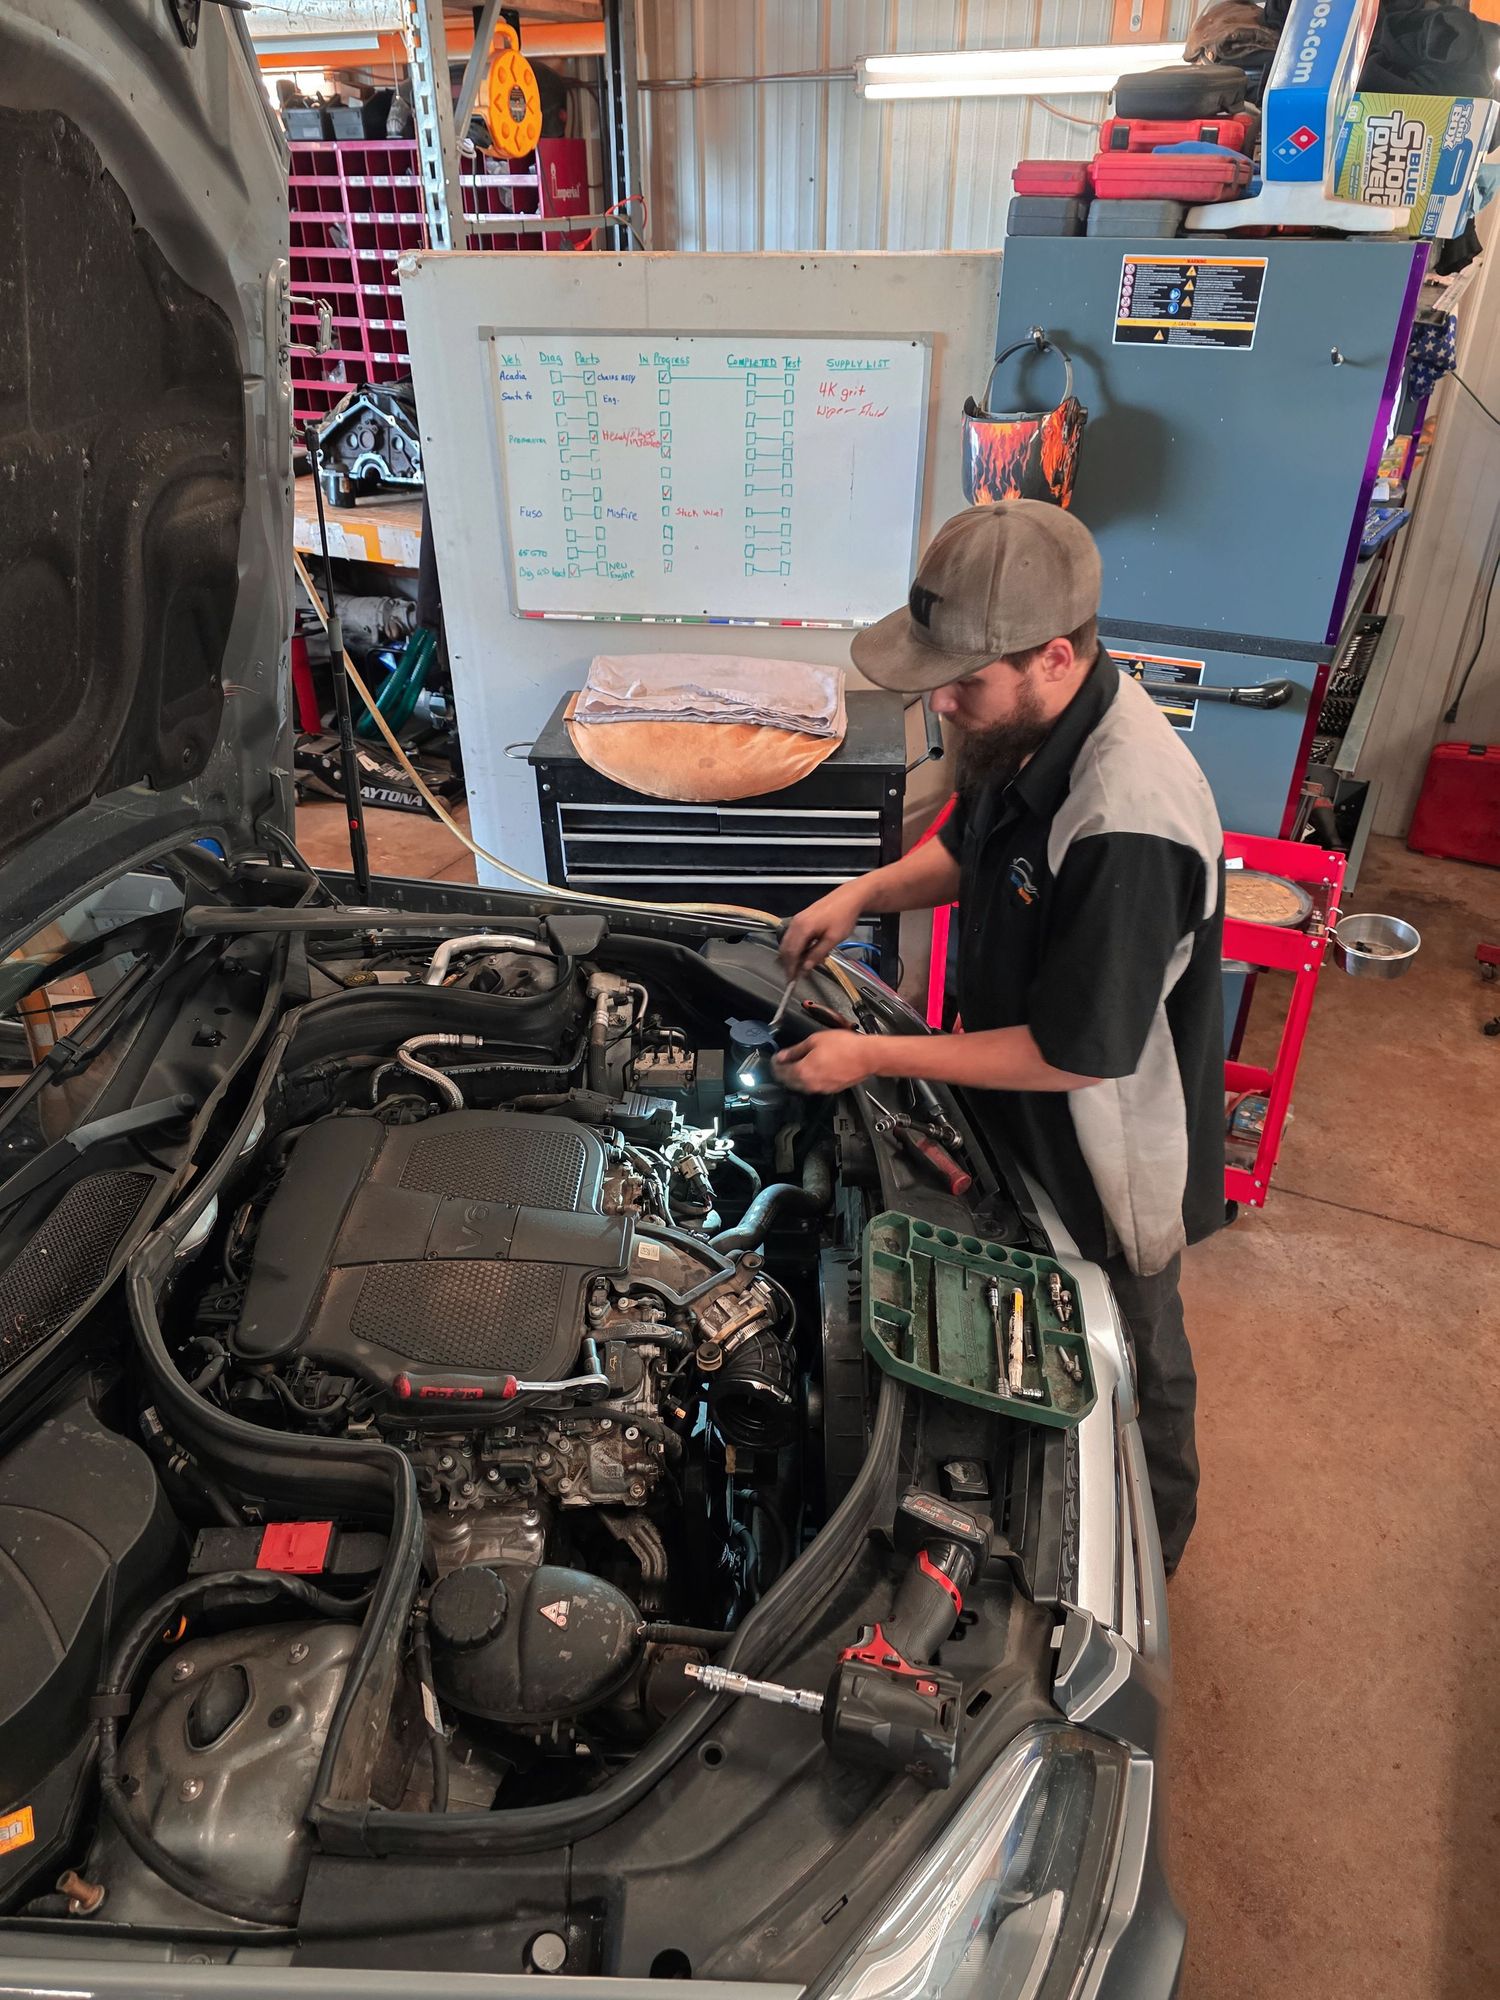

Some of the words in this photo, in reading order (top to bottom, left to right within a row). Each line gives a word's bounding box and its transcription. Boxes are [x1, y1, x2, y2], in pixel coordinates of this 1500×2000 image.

[1292, 0, 1332, 84] os.com
[1384, 120, 1426, 206] SHOP
[1403, 152, 1421, 206] BLUE
[1424, 215, 1438, 232] USA
[653, 352, 690, 367] Progress
[500, 370, 527, 381] Acadia
[819, 381, 838, 397] 4K
[840, 385, 866, 402] grit
[519, 506, 543, 518] Fuso
[607, 506, 640, 521] Misfire
[359, 786, 424, 807] AYTONA
